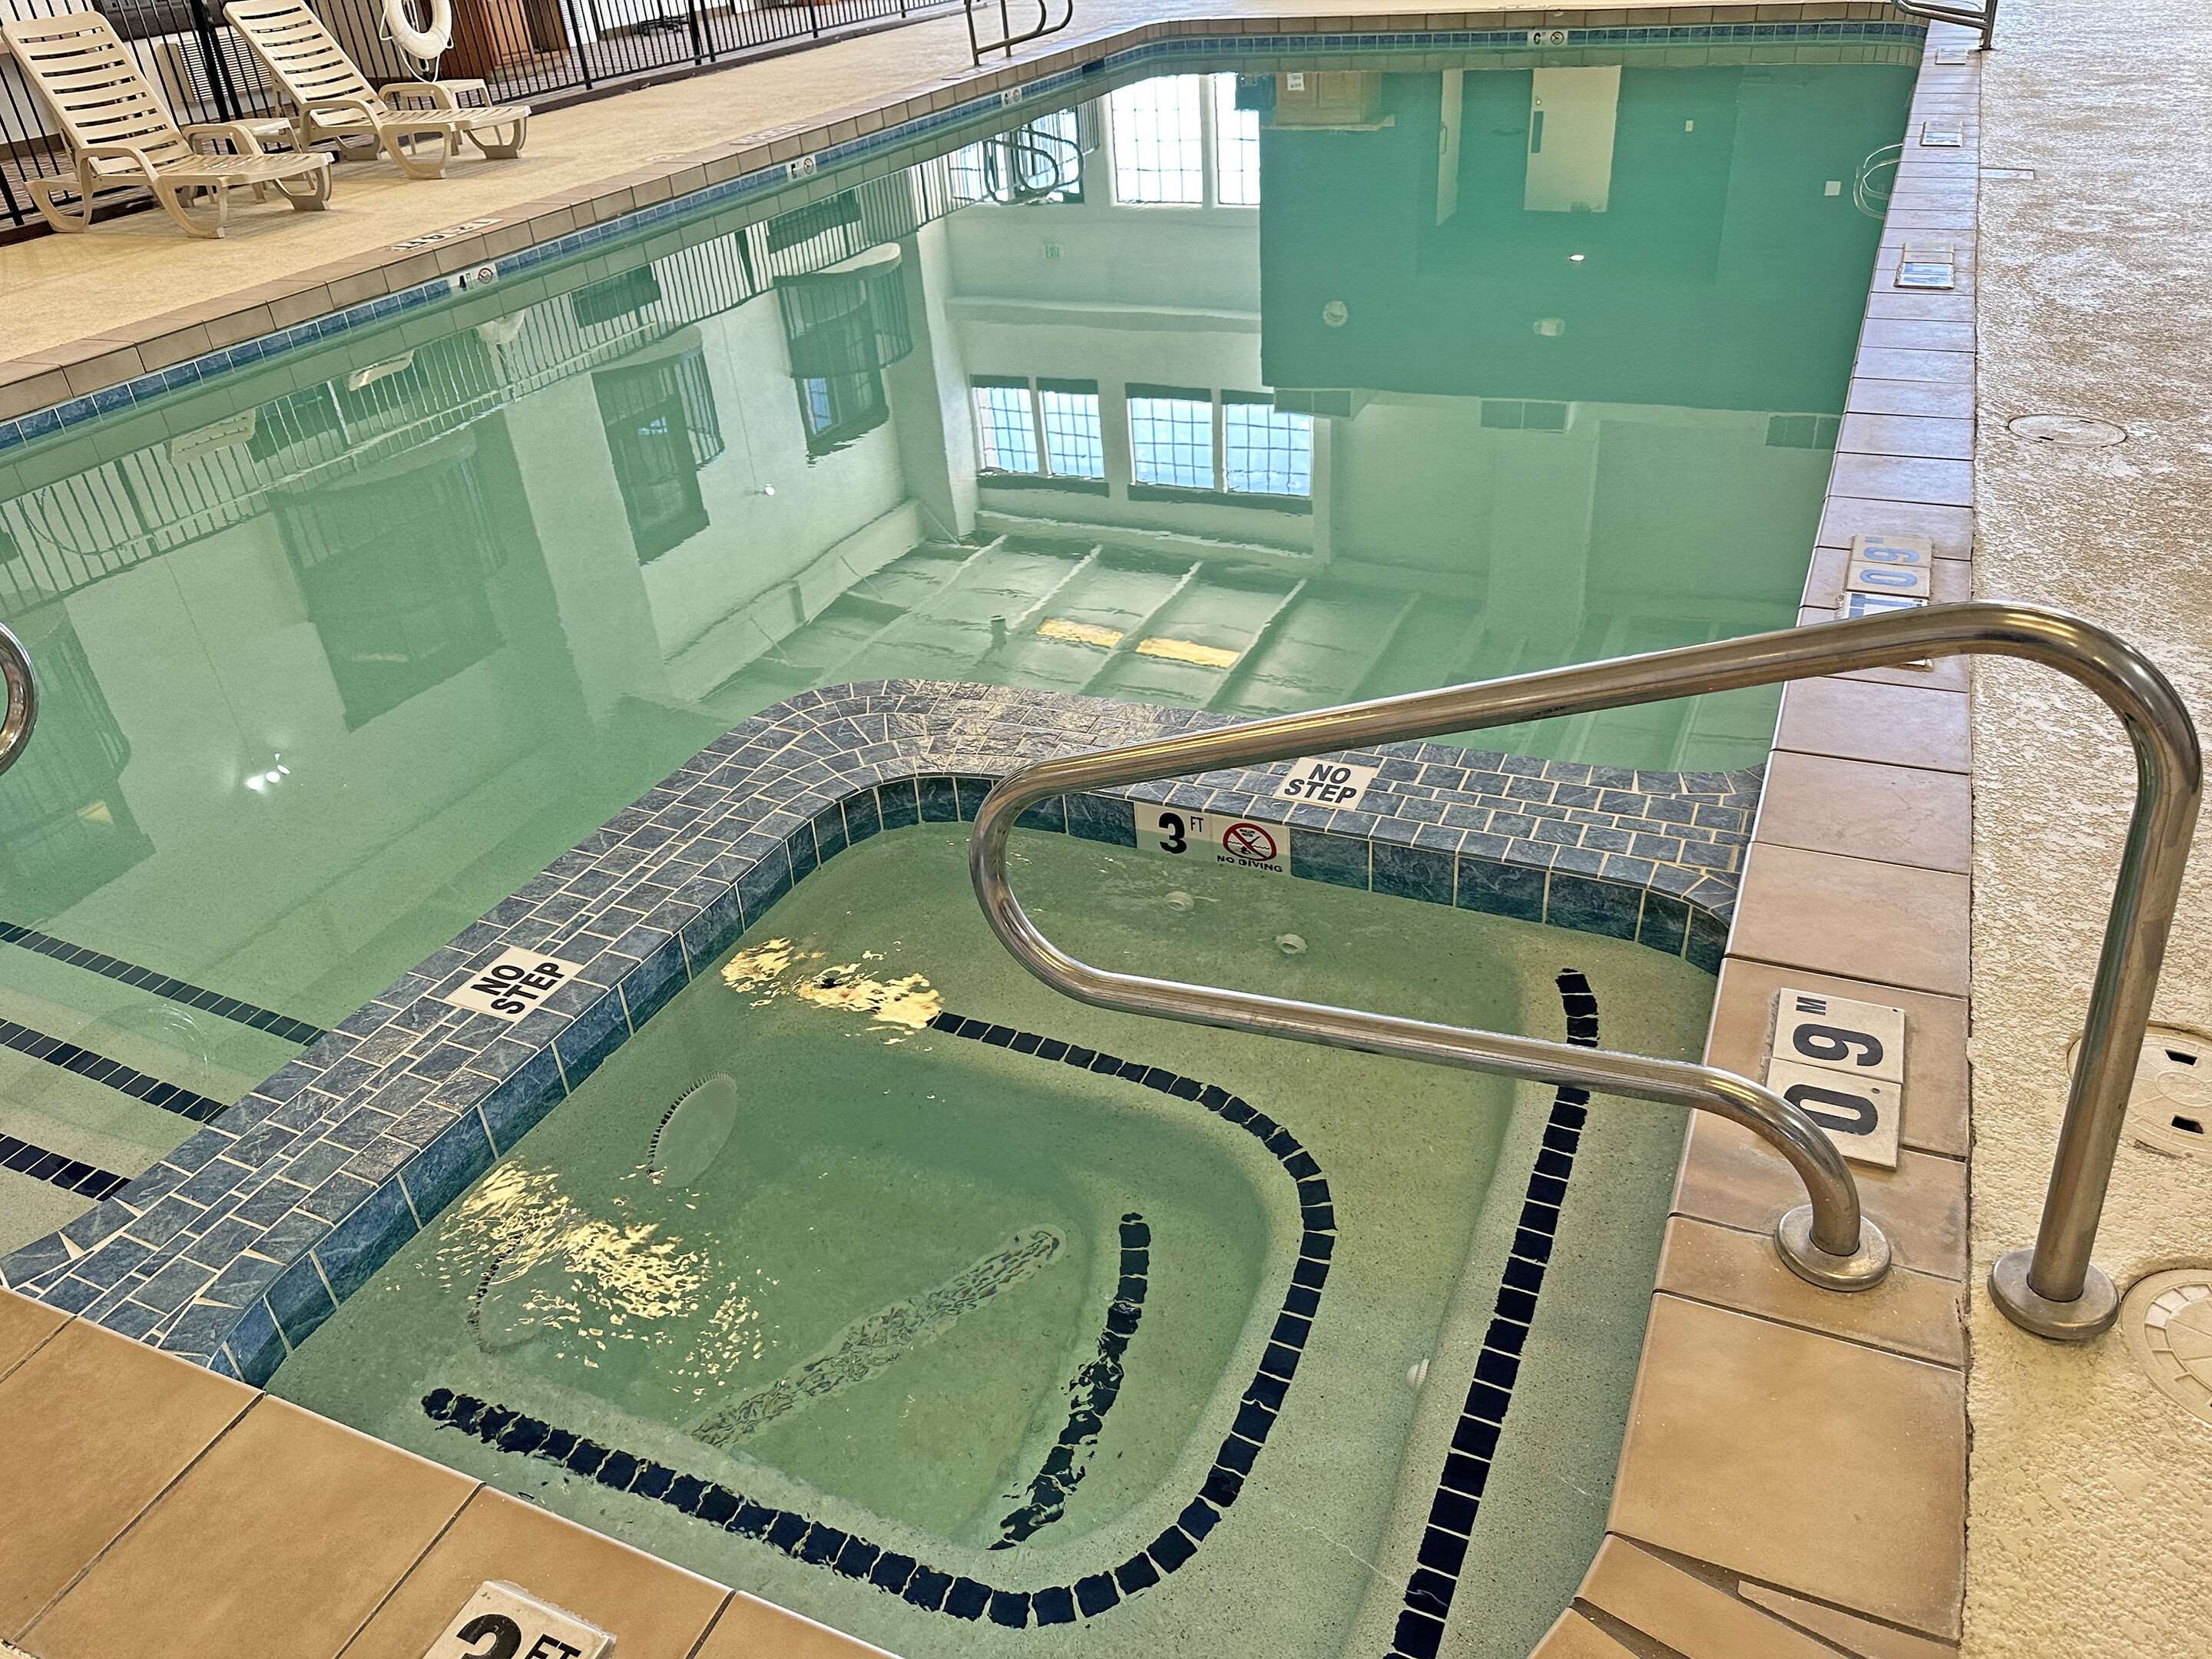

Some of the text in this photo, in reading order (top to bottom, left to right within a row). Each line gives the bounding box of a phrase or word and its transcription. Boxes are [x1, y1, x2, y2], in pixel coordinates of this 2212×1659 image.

[1309, 763, 1352, 785] NO
[1284, 778, 1357, 804] STEP
[1158, 812, 1204, 855] 3 FT
[1217, 855, 1283, 873] NO DIVING
[470, 965, 525, 996] NO
[490, 962, 565, 1015] STEP
[1795, 996, 1826, 1015] M
